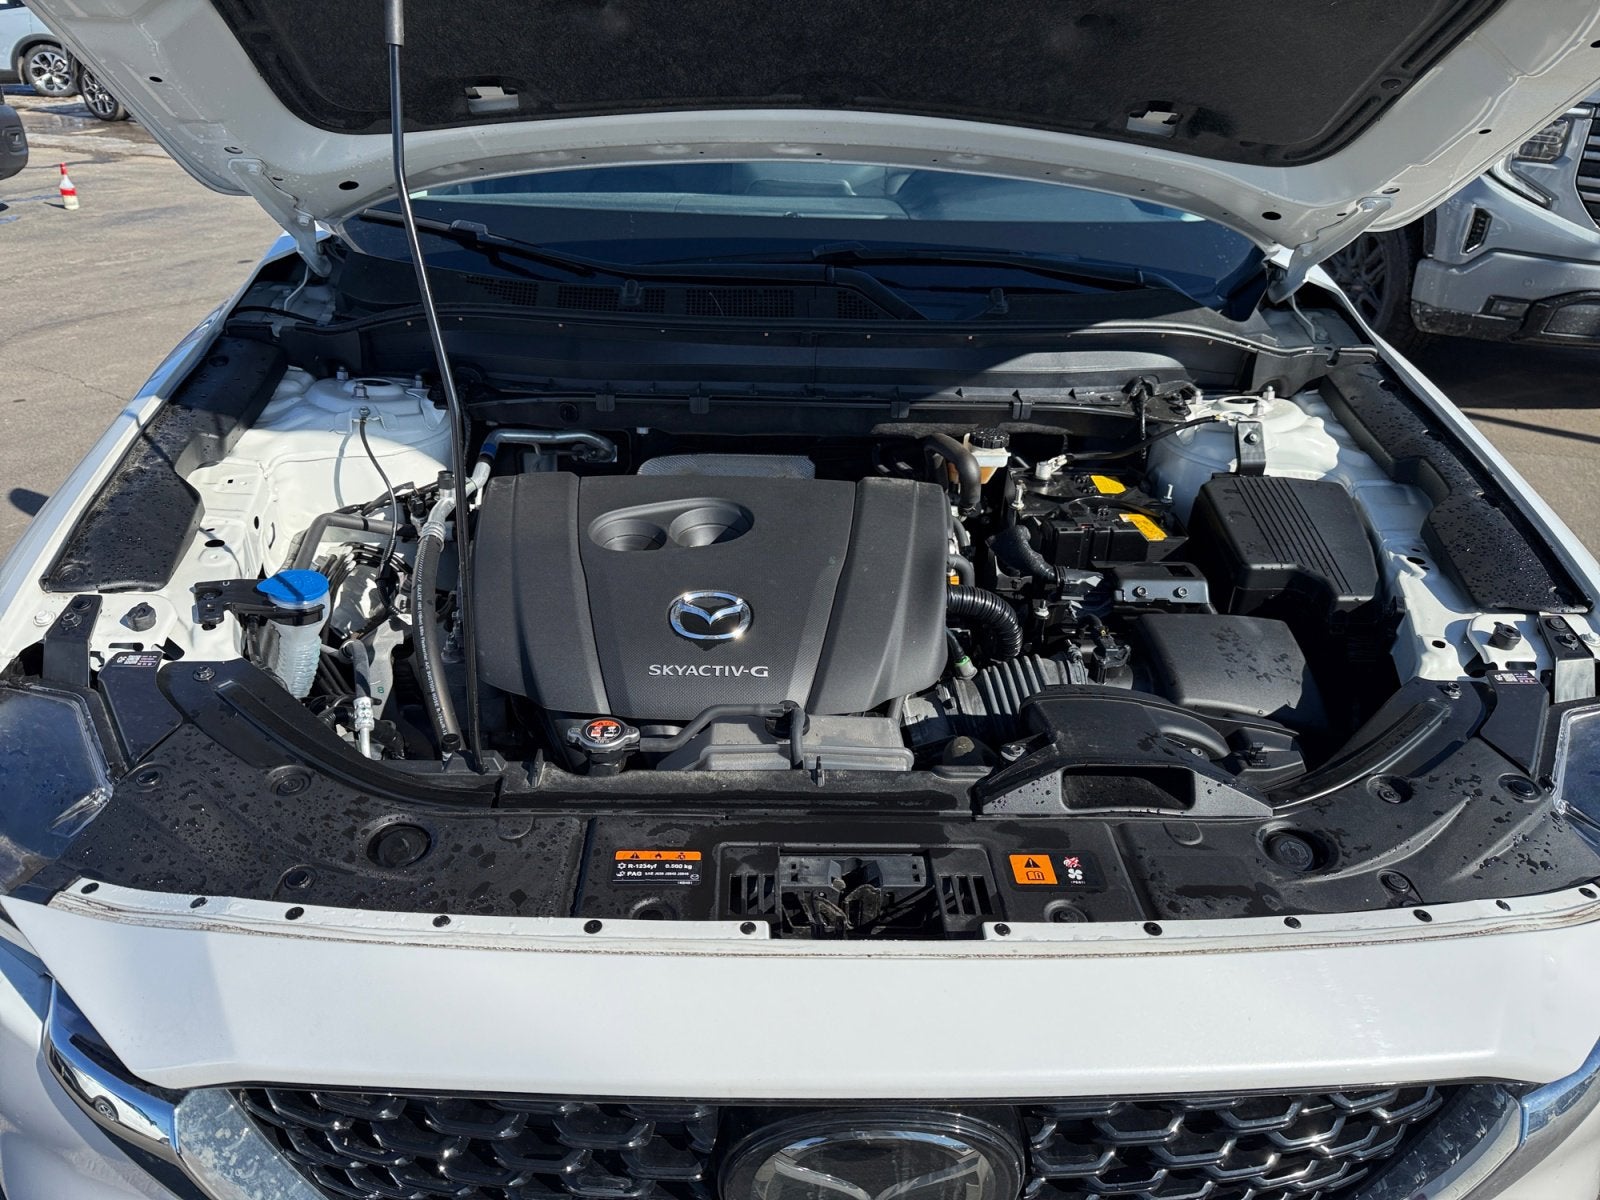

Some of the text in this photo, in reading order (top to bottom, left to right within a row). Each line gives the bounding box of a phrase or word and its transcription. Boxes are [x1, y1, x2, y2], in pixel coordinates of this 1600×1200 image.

[648, 664, 768, 678] SKYACTIV-G
[426, 671, 436, 692] SUCTION
[431, 692, 439, 707] HOSE
